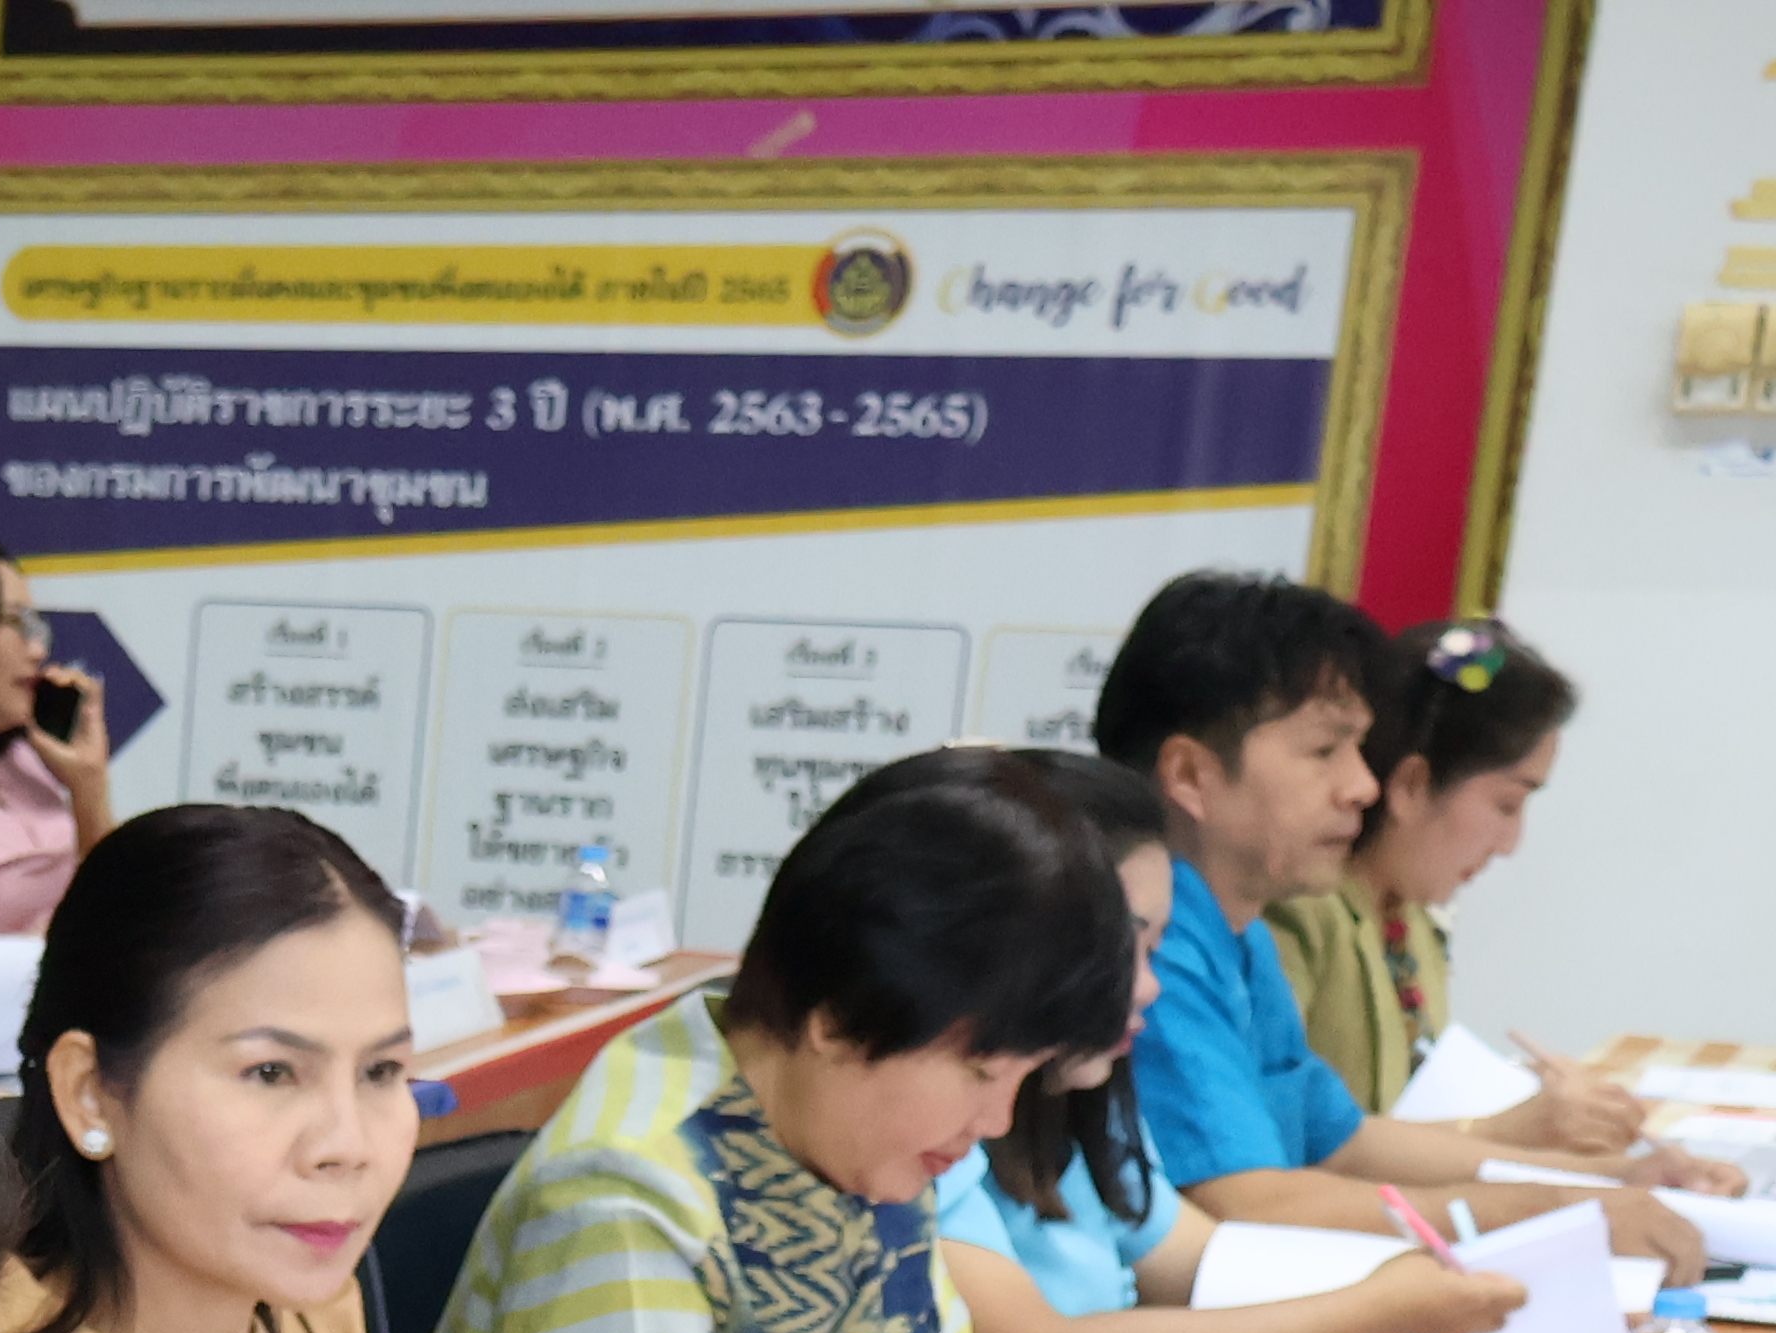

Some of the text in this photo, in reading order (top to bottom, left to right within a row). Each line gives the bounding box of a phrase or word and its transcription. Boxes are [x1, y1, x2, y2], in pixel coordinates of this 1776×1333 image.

[1110, 261, 1180, 332] for
[485, 385, 518, 432] 3
[526, 375, 570, 434] ปี
